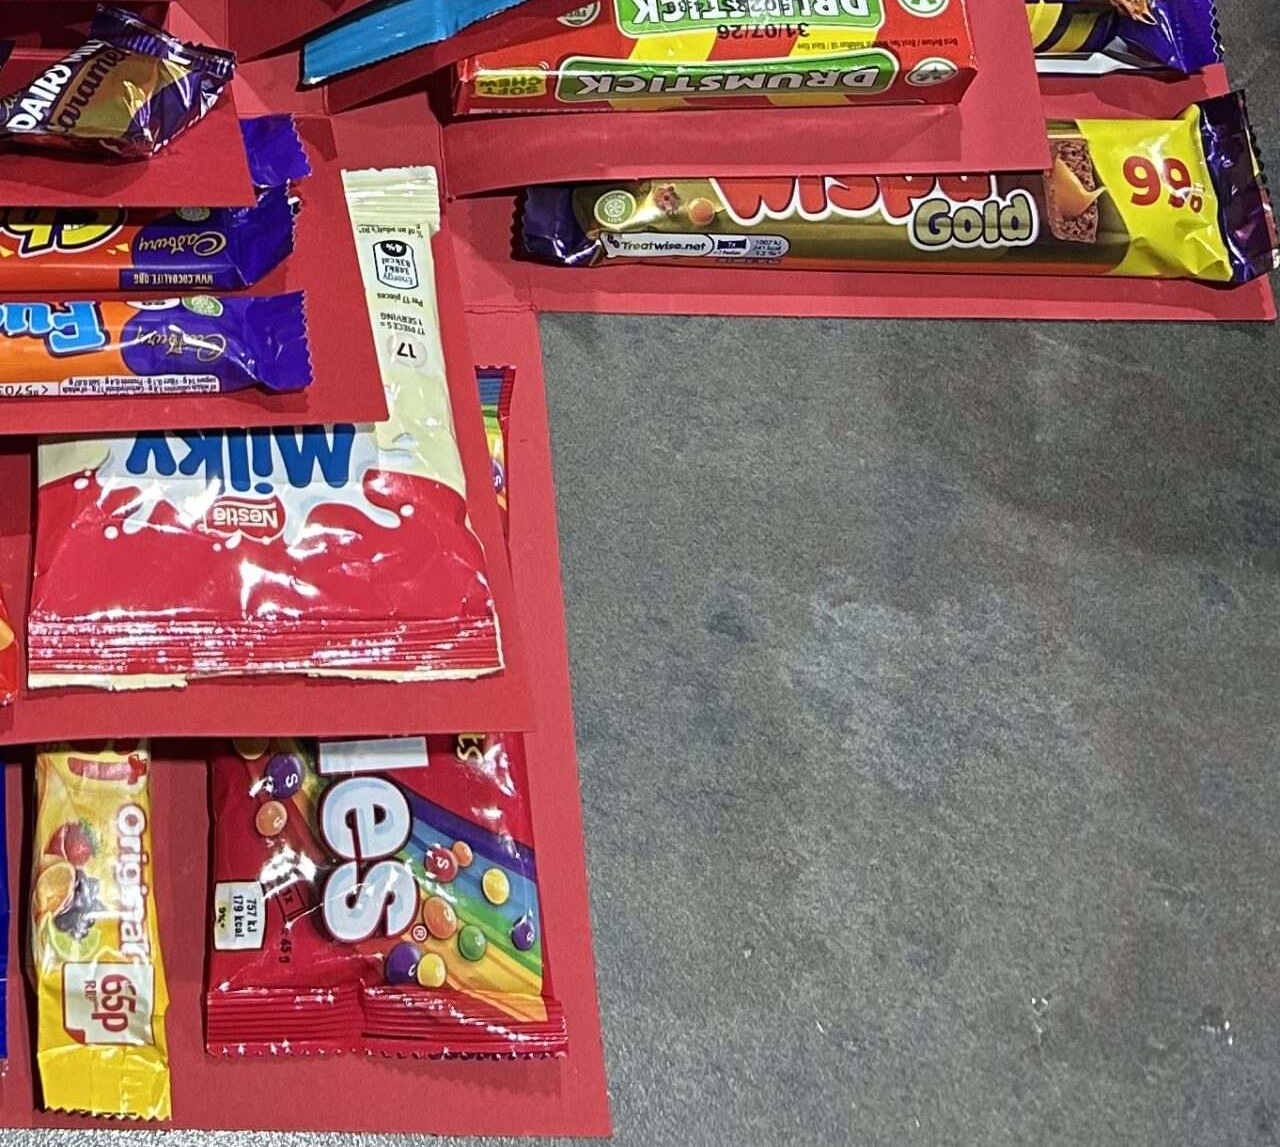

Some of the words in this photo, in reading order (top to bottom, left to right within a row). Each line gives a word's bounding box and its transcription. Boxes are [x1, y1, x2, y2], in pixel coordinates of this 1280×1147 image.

[716, 20, 810, 40] 31/07/26
[576, 68, 878, 96] DRUMSTICK
[481, 86, 539, 97] SOFT
[914, 197, 1033, 245] Gold
[138, 232, 226, 256] Cadbury
[621, 239, 707, 253] Treatwise.net
[133, 271, 214, 285] WWW.COCOALIFE.ORG
[383, 272, 413, 286] Energy
[377, 293, 401, 302] pieces
[412, 298, 423, 307] Per
[380, 313, 417, 326] SERVING
[387, 321, 416, 333] PIECES
[133, 325, 227, 363] Cadbury
[397, 342, 417, 359] 17
[125, 424, 354, 494] Milky
[232, 895, 244, 913] 179
[245, 899, 257, 917] 757
[233, 915, 246, 938] kcal
[245, 920, 259, 934] kJ
[98, 974, 139, 1032] 65p
